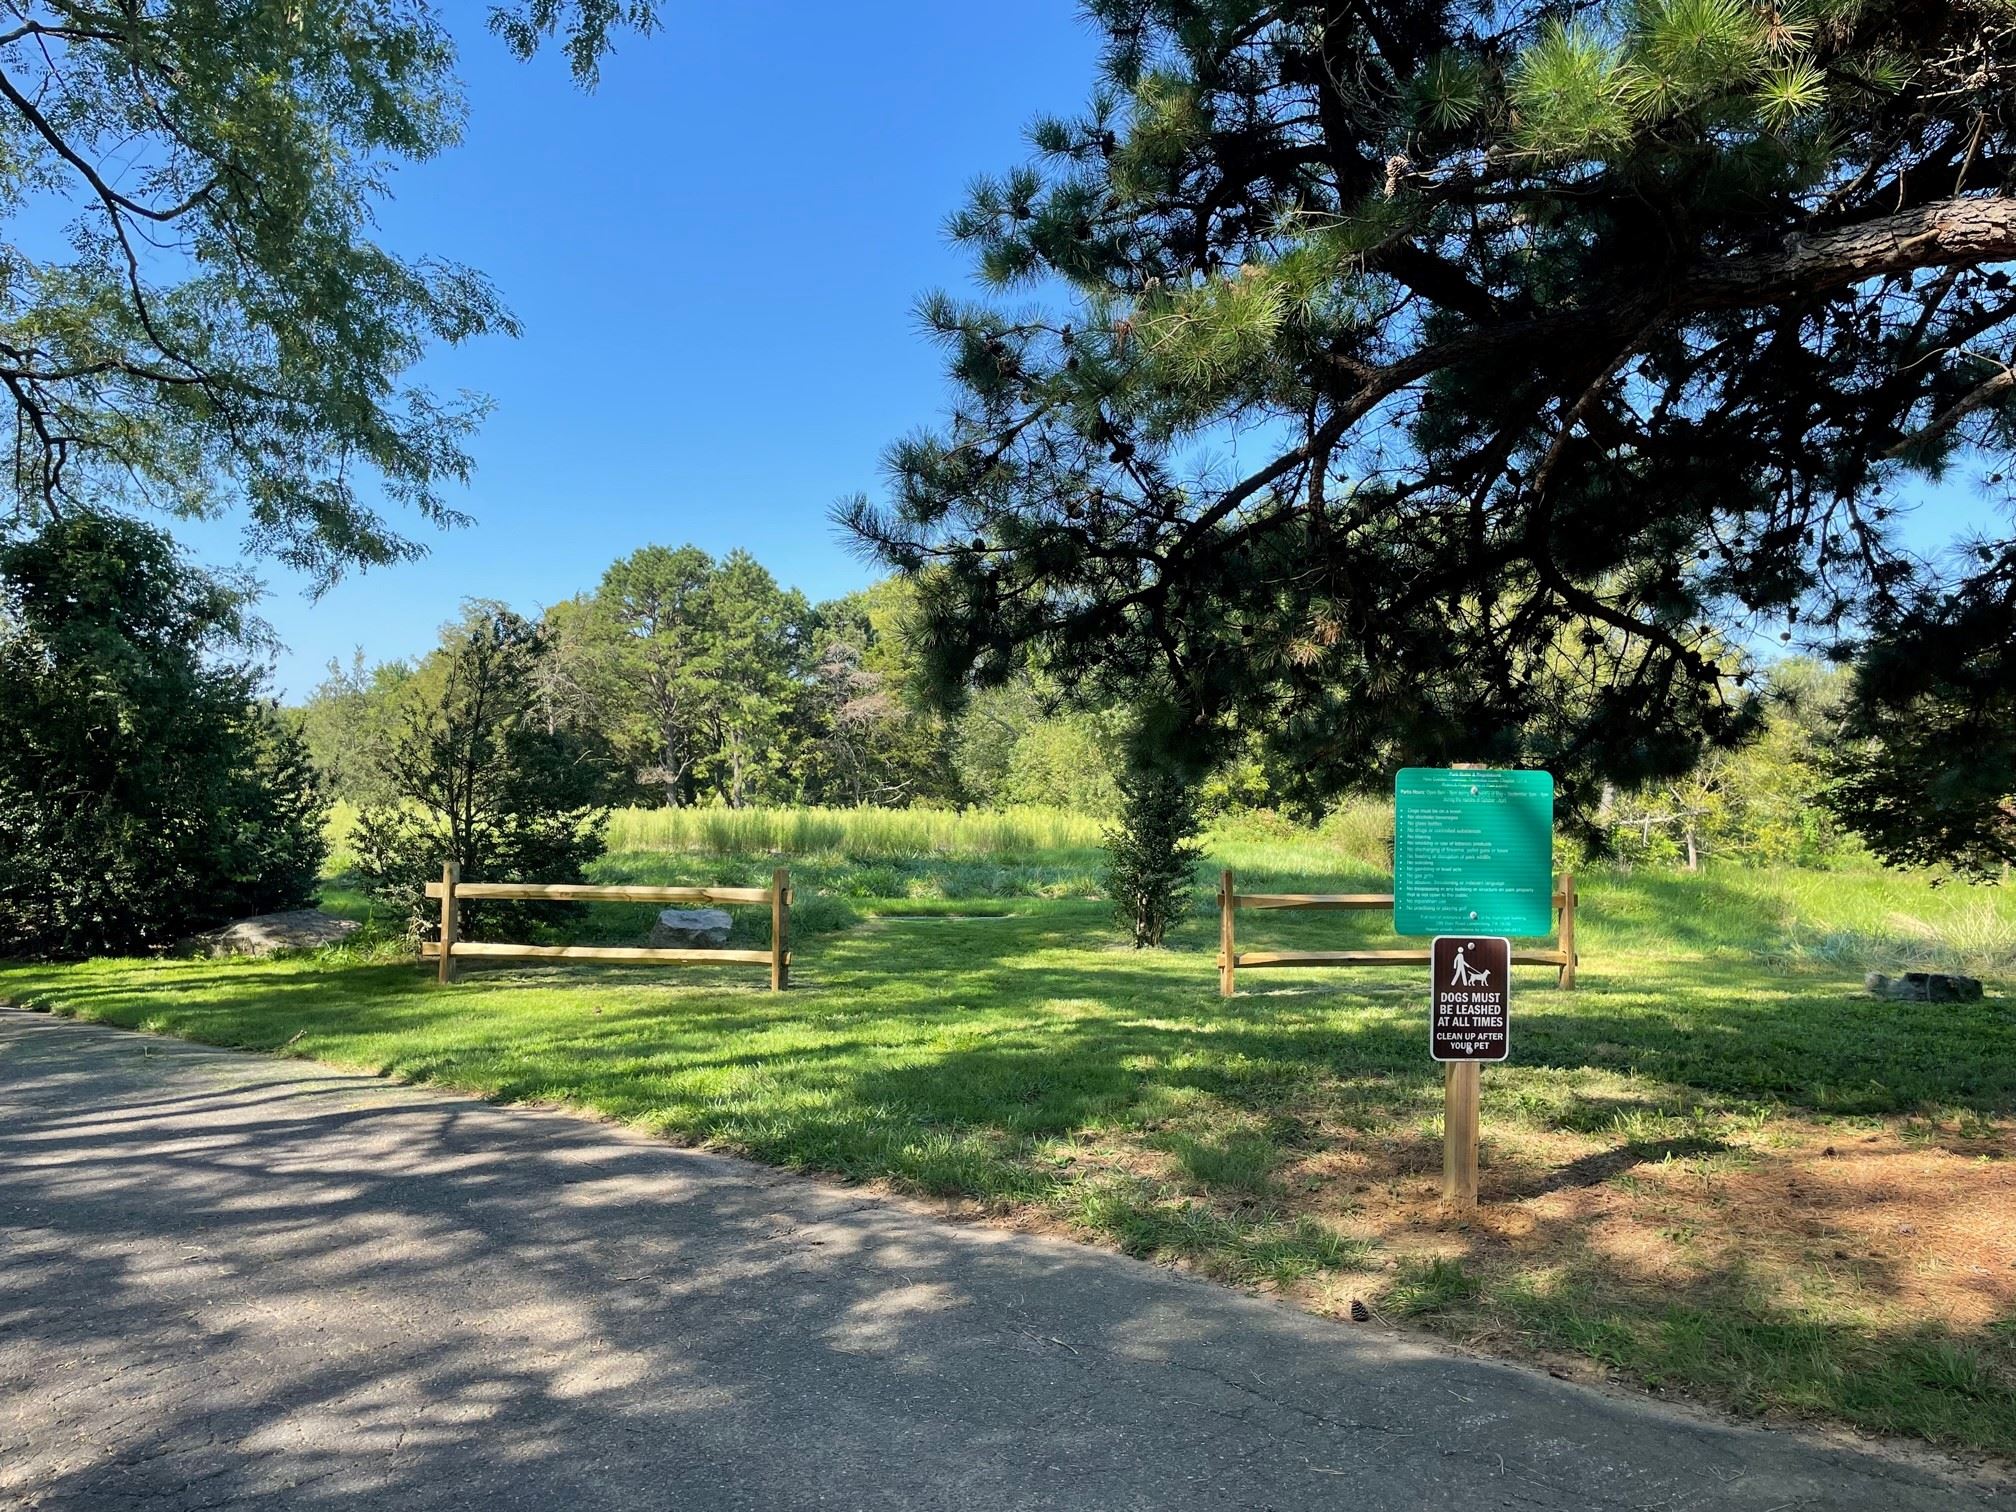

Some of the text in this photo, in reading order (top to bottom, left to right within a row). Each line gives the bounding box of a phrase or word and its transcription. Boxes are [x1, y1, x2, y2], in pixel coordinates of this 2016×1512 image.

[1441, 992, 1501, 1003] DOGS MUST
[1440, 1004, 1501, 1015] BE LEASHED
[1437, 1016, 1503, 1027] AT ALL TIMES
[1436, 1032, 1504, 1041] CLEAN UP AFTER
[1450, 1042, 1490, 1050] YOUR PET
